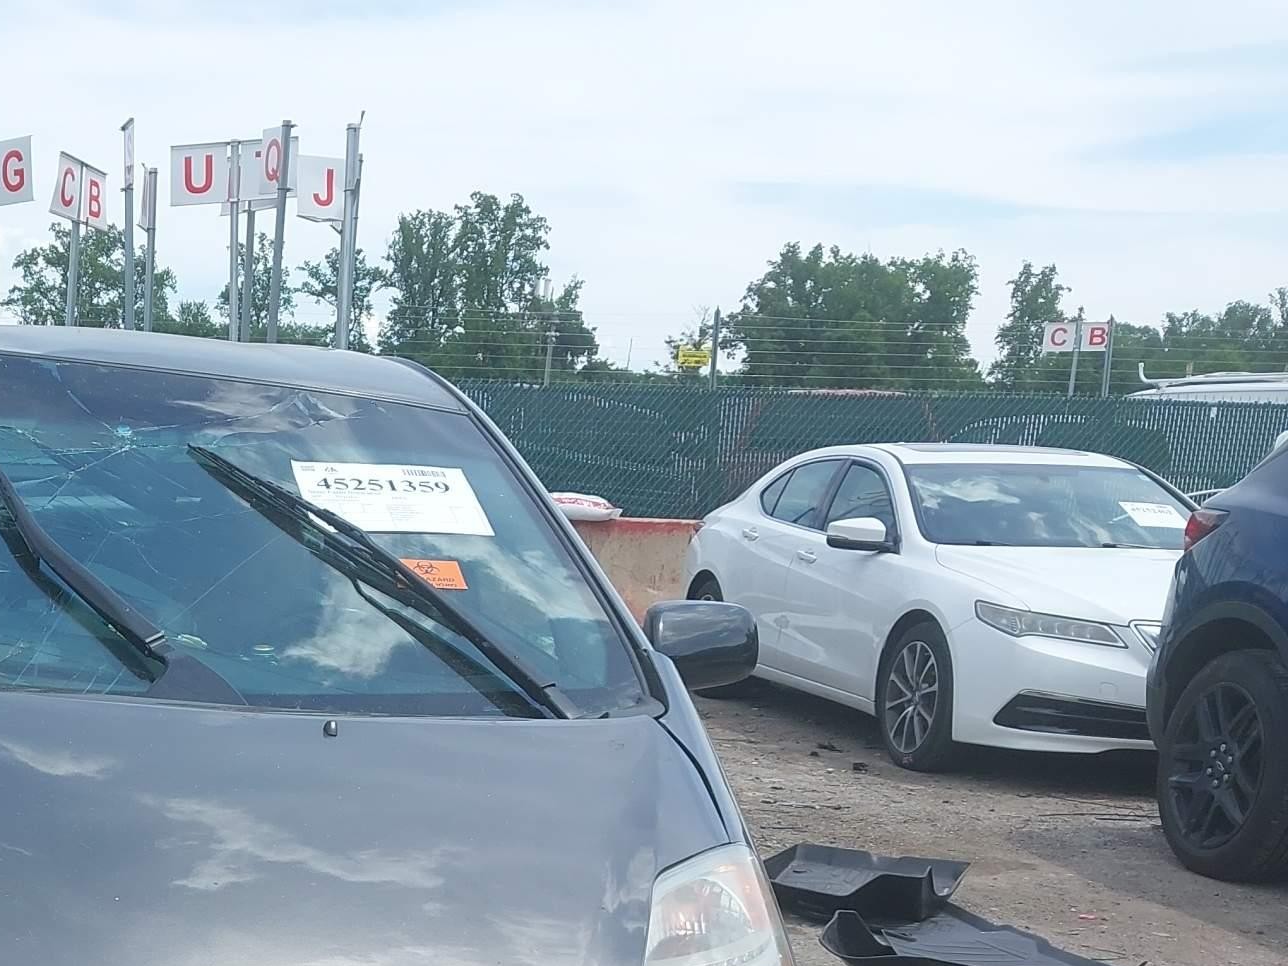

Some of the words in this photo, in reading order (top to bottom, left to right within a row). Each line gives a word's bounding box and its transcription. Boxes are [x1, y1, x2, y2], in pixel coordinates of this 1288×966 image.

[2, 150, 25, 193] G
[184, 154, 214, 194] U
[264, 138, 281, 182] Q
[60, 167, 75, 208] C
[88, 178, 101, 219] B
[313, 168, 334, 207] J
[1050, 327, 1068, 346] C
[1088, 326, 1108, 346] B
[316, 476, 451, 495] 45251359
